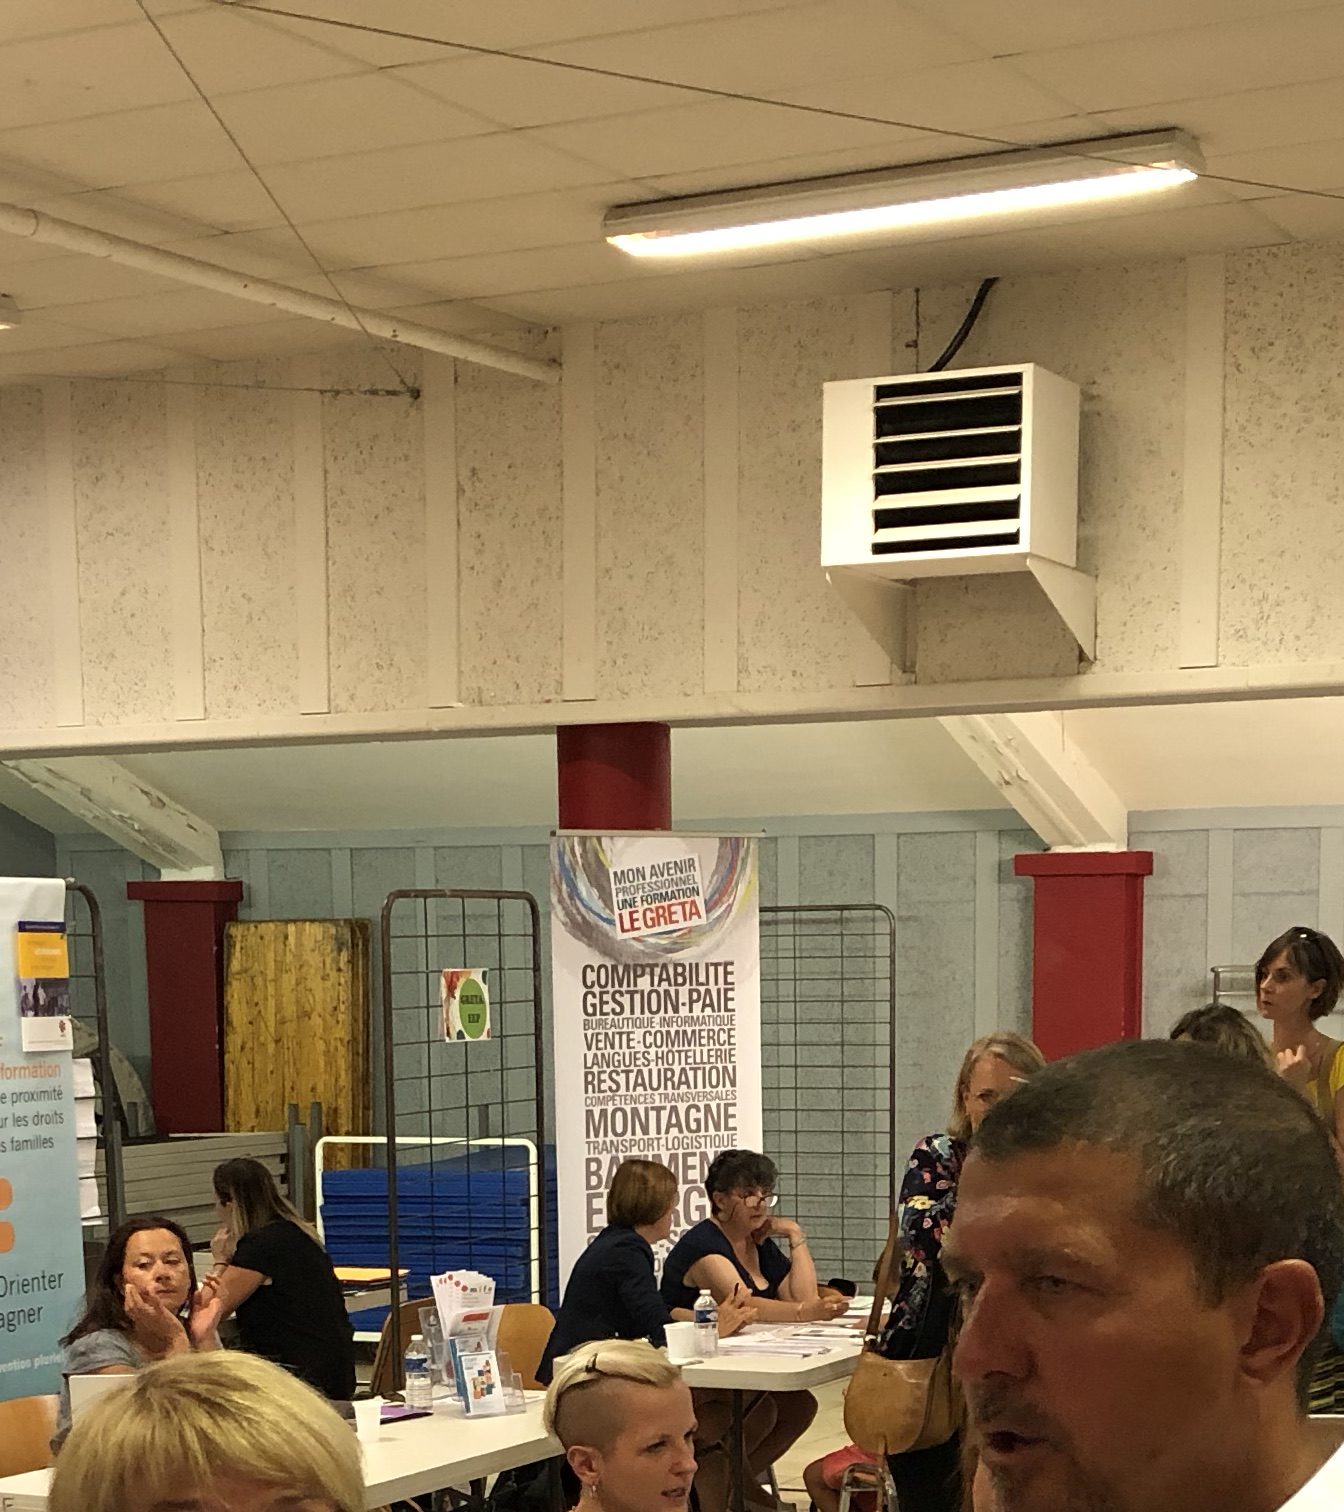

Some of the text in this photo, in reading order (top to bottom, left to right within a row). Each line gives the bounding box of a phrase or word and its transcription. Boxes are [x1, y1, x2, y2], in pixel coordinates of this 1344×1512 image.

[612, 857, 697, 886] MON AVENIR
[614, 874, 698, 898] PROFESSIONNEL
[616, 885, 700, 911] UNE FORMATION
[618, 898, 702, 934] LE GRETA
[582, 987, 736, 1017] GESTION-PAIE
[584, 1065, 737, 1095] RESTAURATION
[11, 1085, 64, 1107] proximité
[657, 1089, 738, 1105] TRANSVERSALES
[12, 1112, 29, 1128] les
[32, 1111, 65, 1126] droits
[585, 1102, 738, 1140] MONTAGNE
[10, 1134, 55, 1152] familles
[585, 1133, 738, 1156] TRANSPORT-LOGISTIQUE
